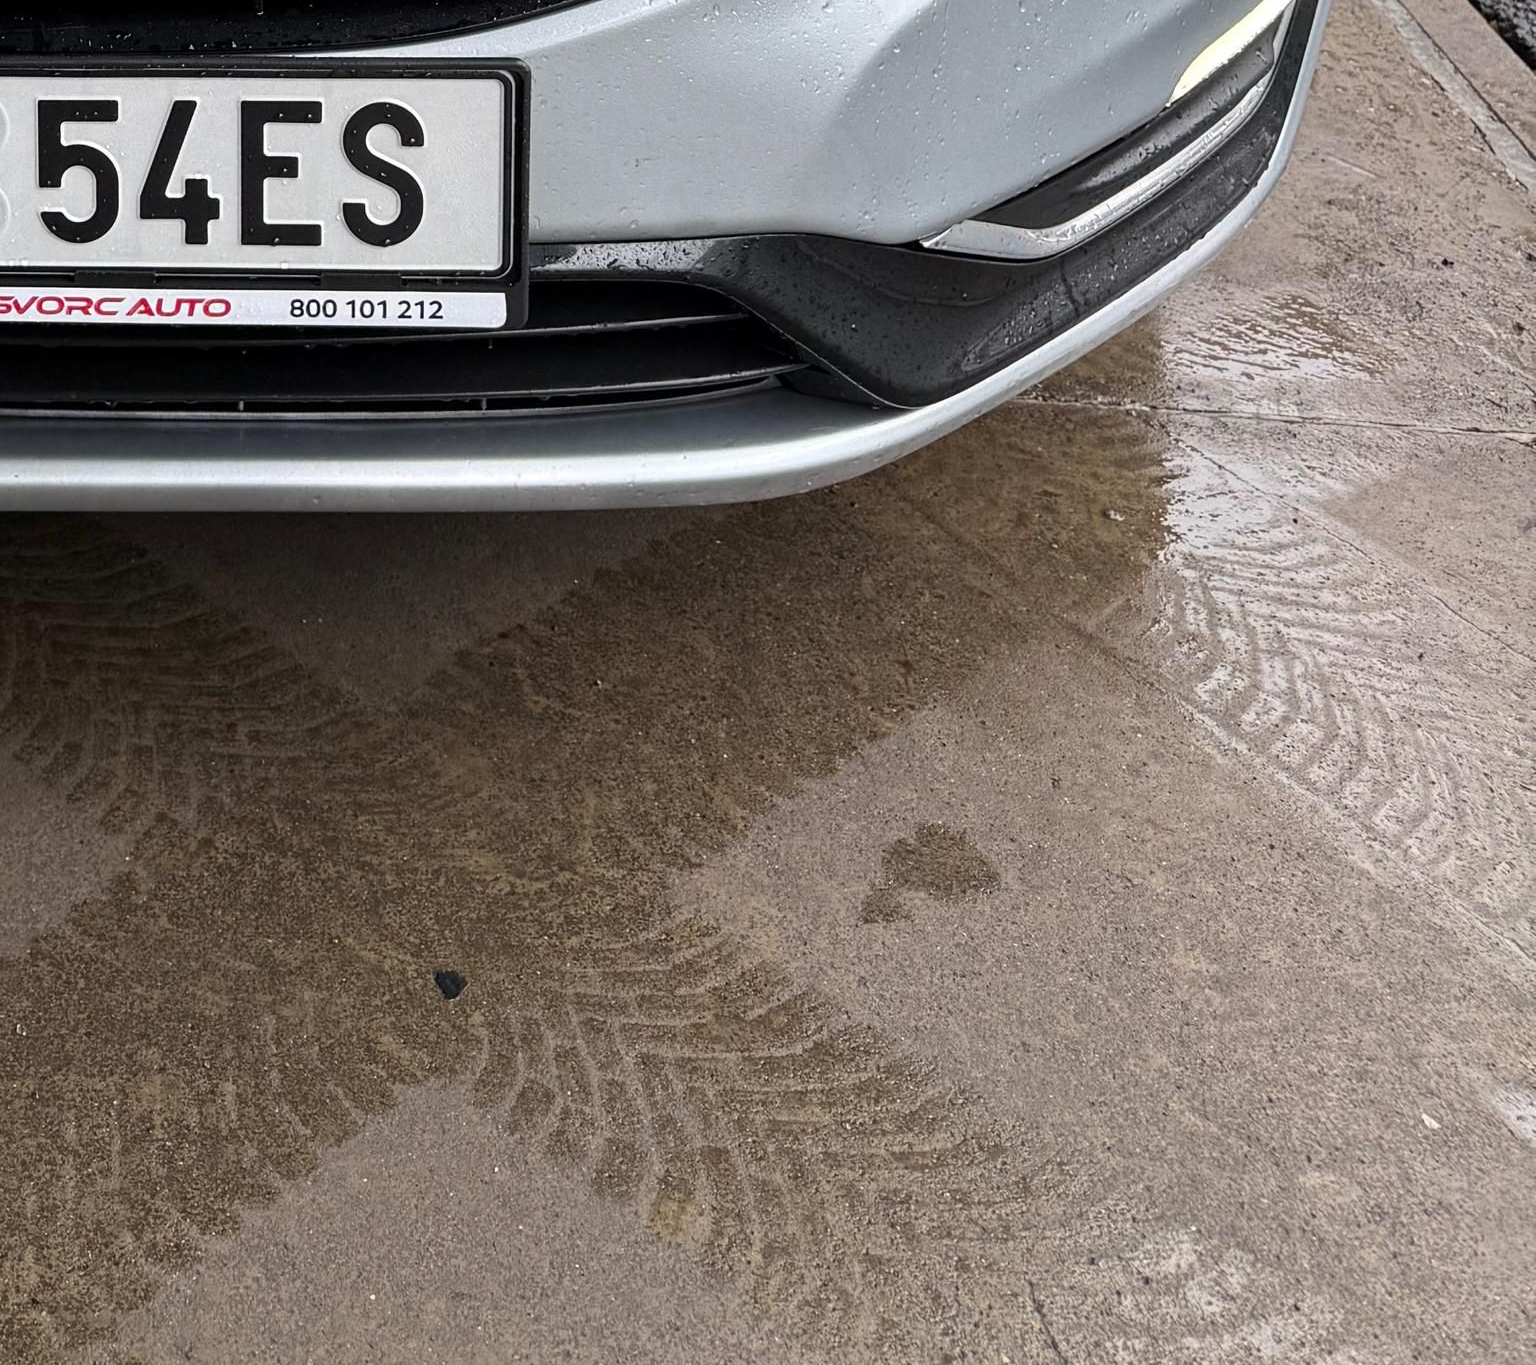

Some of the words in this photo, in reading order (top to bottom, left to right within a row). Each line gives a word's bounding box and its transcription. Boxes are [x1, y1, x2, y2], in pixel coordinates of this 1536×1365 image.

[37, 99, 425, 248] 54ES
[289, 298, 338, 318] 800
[345, 299, 388, 319] 101
[397, 300, 444, 320] 212
